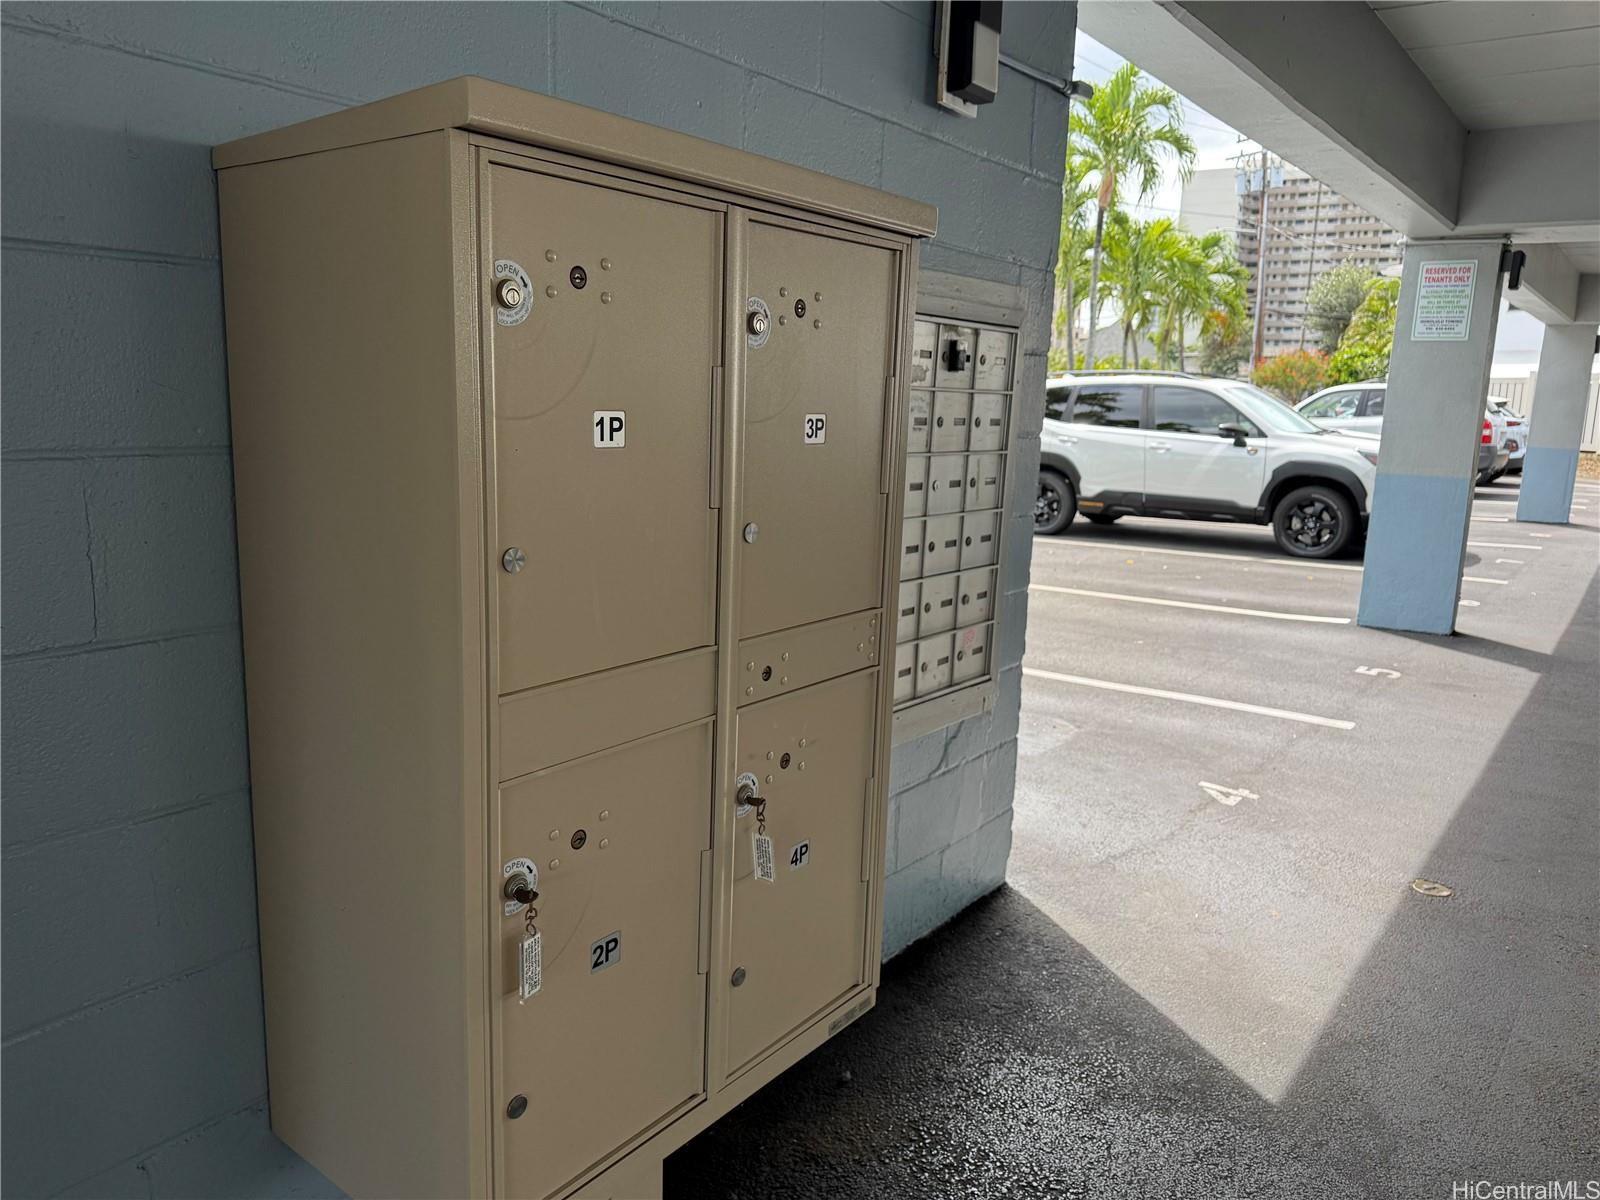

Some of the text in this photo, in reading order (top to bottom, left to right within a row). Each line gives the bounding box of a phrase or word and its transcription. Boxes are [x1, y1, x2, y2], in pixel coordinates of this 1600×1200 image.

[496, 263, 520, 277] OPEN
[1424, 266, 1472, 275] RESERVED FOR
[1453, 275, 1471, 283] ONLY
[749, 299, 764, 310] OPEN
[595, 416, 623, 442] 1P
[806, 418, 825, 439] 3P
[1355, 665, 1401, 679] 5
[1198, 781, 1260, 806] 4
[791, 843, 809, 866] 4P
[505, 860, 526, 873] OPEN
[592, 937, 619, 970] 2P
